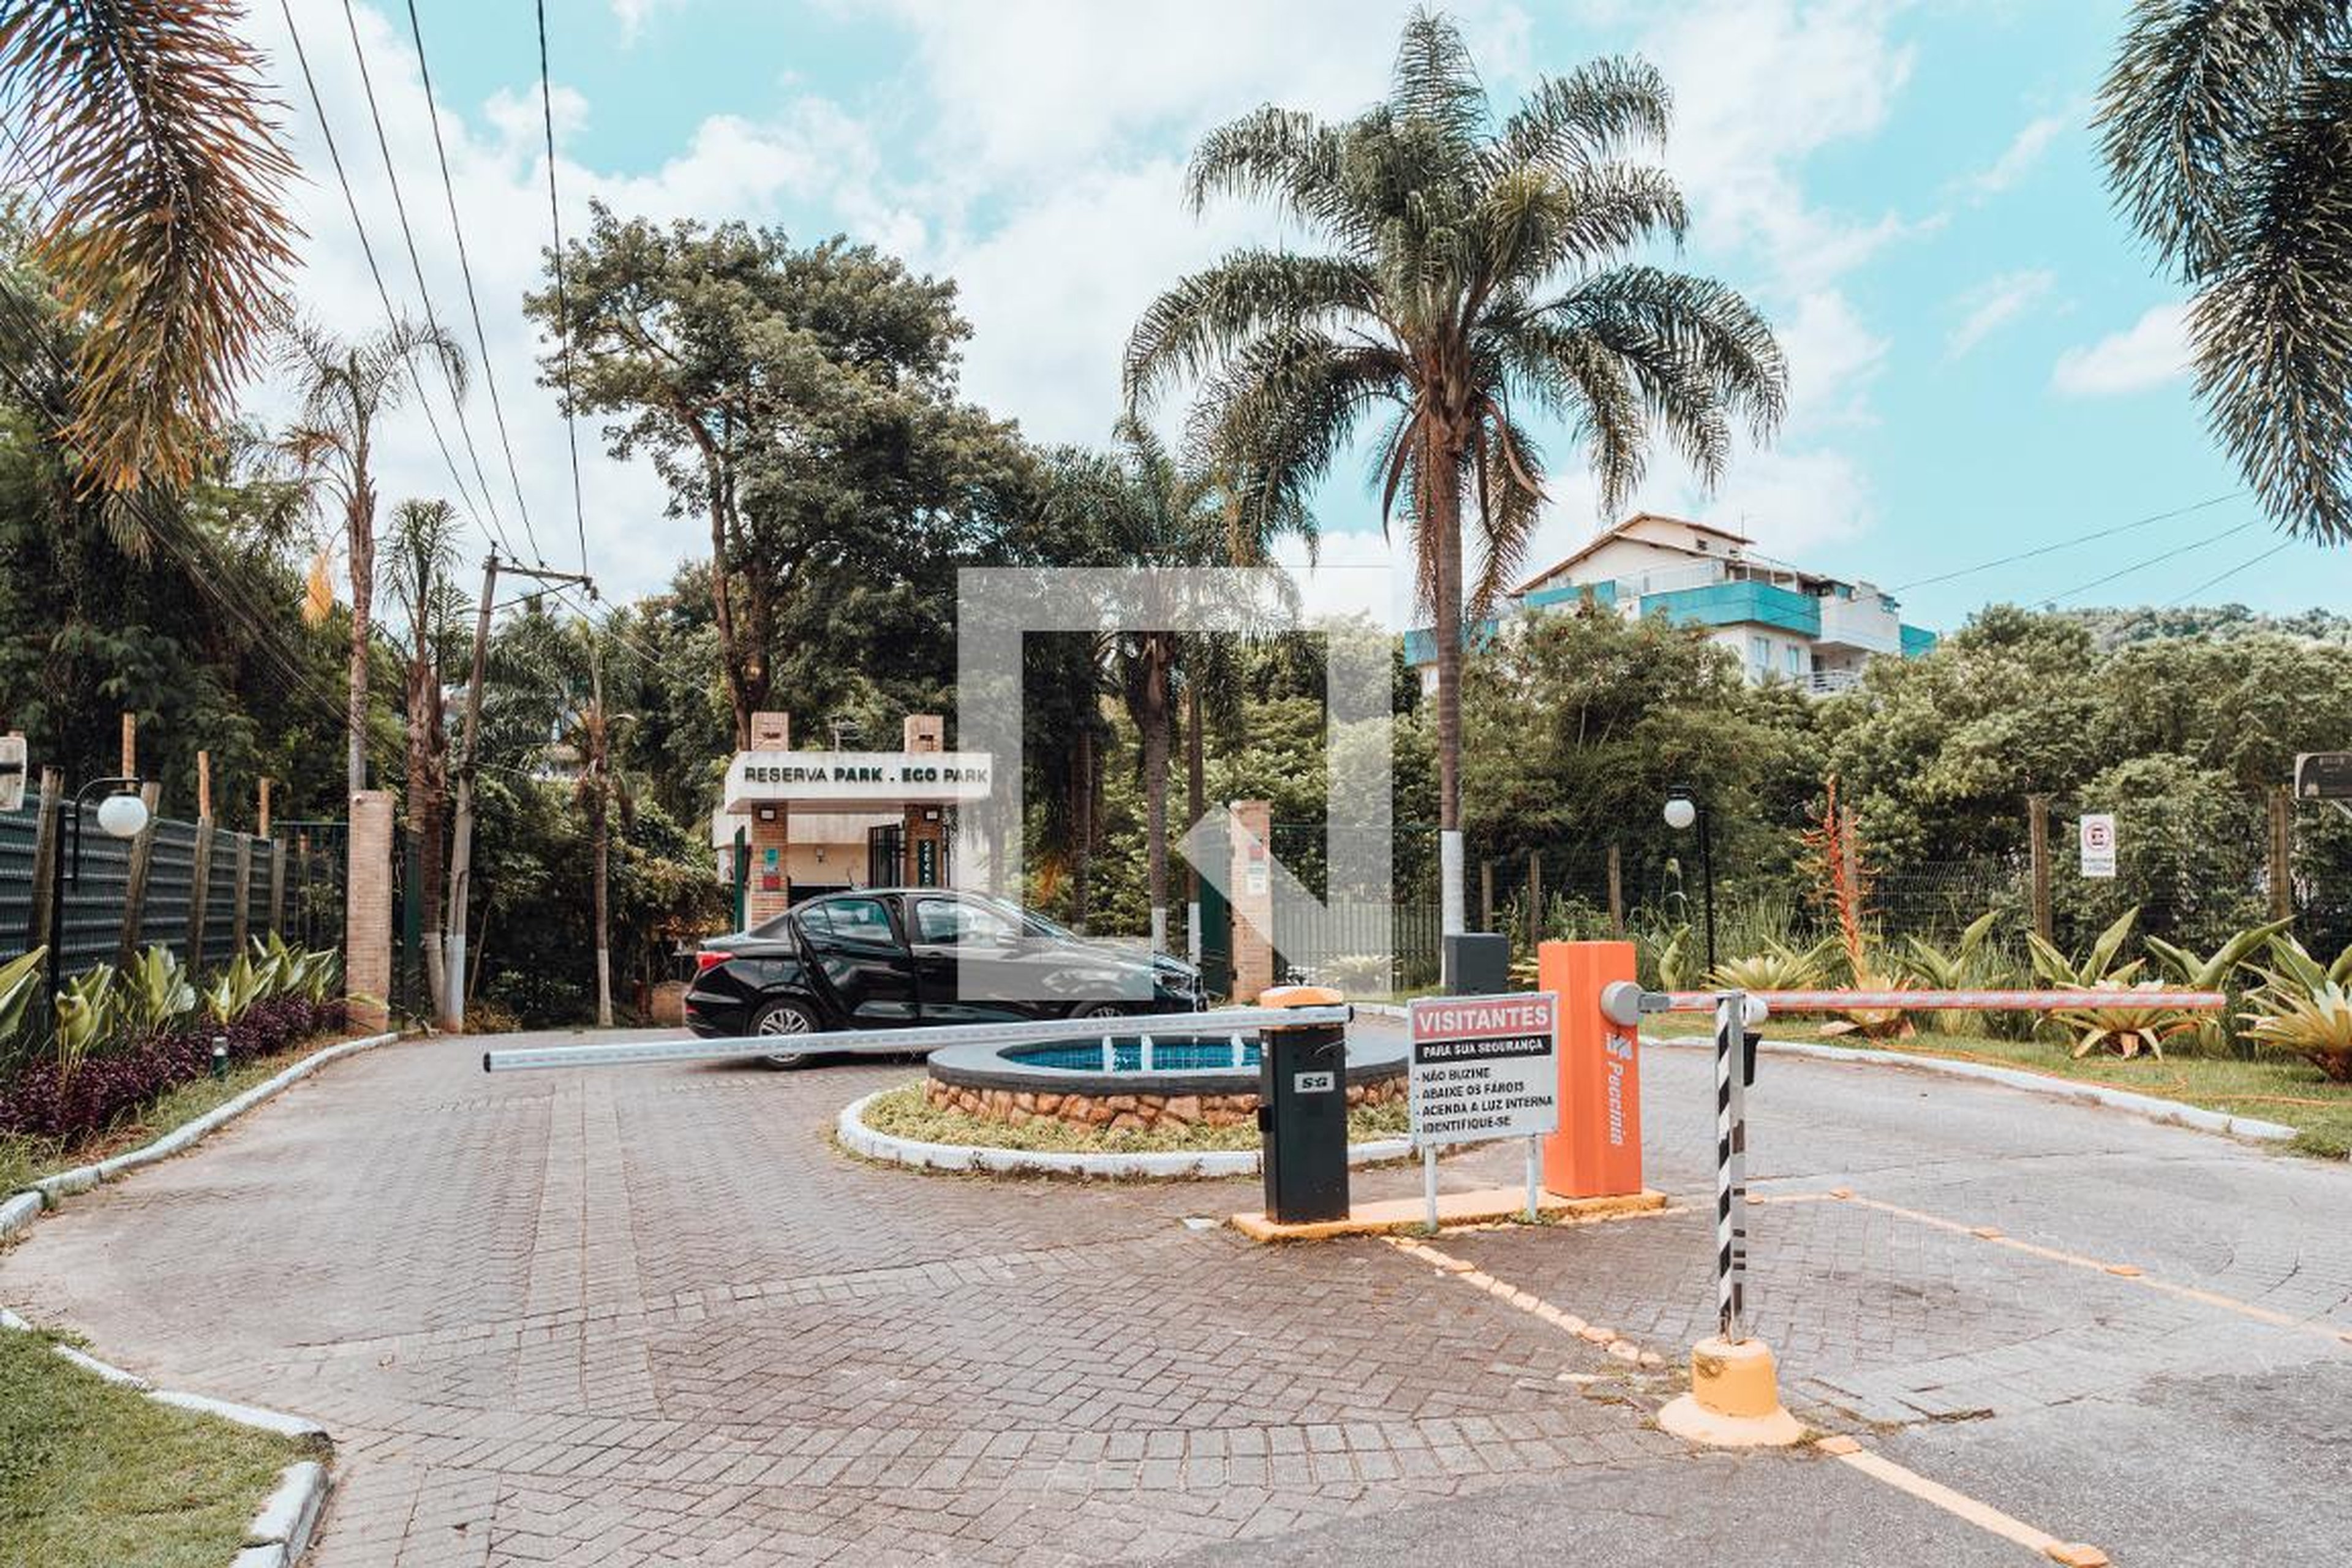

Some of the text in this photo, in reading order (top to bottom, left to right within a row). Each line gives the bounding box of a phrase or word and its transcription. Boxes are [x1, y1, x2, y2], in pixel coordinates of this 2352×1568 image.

[745, 766, 827, 782] RESERVA
[834, 767, 882, 782] PARK
[902, 767, 937, 782] ECO
[944, 768, 988, 782] PARK
[1419, 1006, 1548, 1033] VISITANTES
[1423, 1038, 1544, 1058] PARA SUA SEGURANÇA
[1449, 1067, 1490, 1081] BUZINE
[1422, 1085, 1463, 1099] ABAIXE
[1466, 1084, 1481, 1095] OS
[1422, 1095, 1553, 1117] ACENDA A LUZ INTERNA
[1423, 1116, 1511, 1133] IDENTIFIQUE-SE
